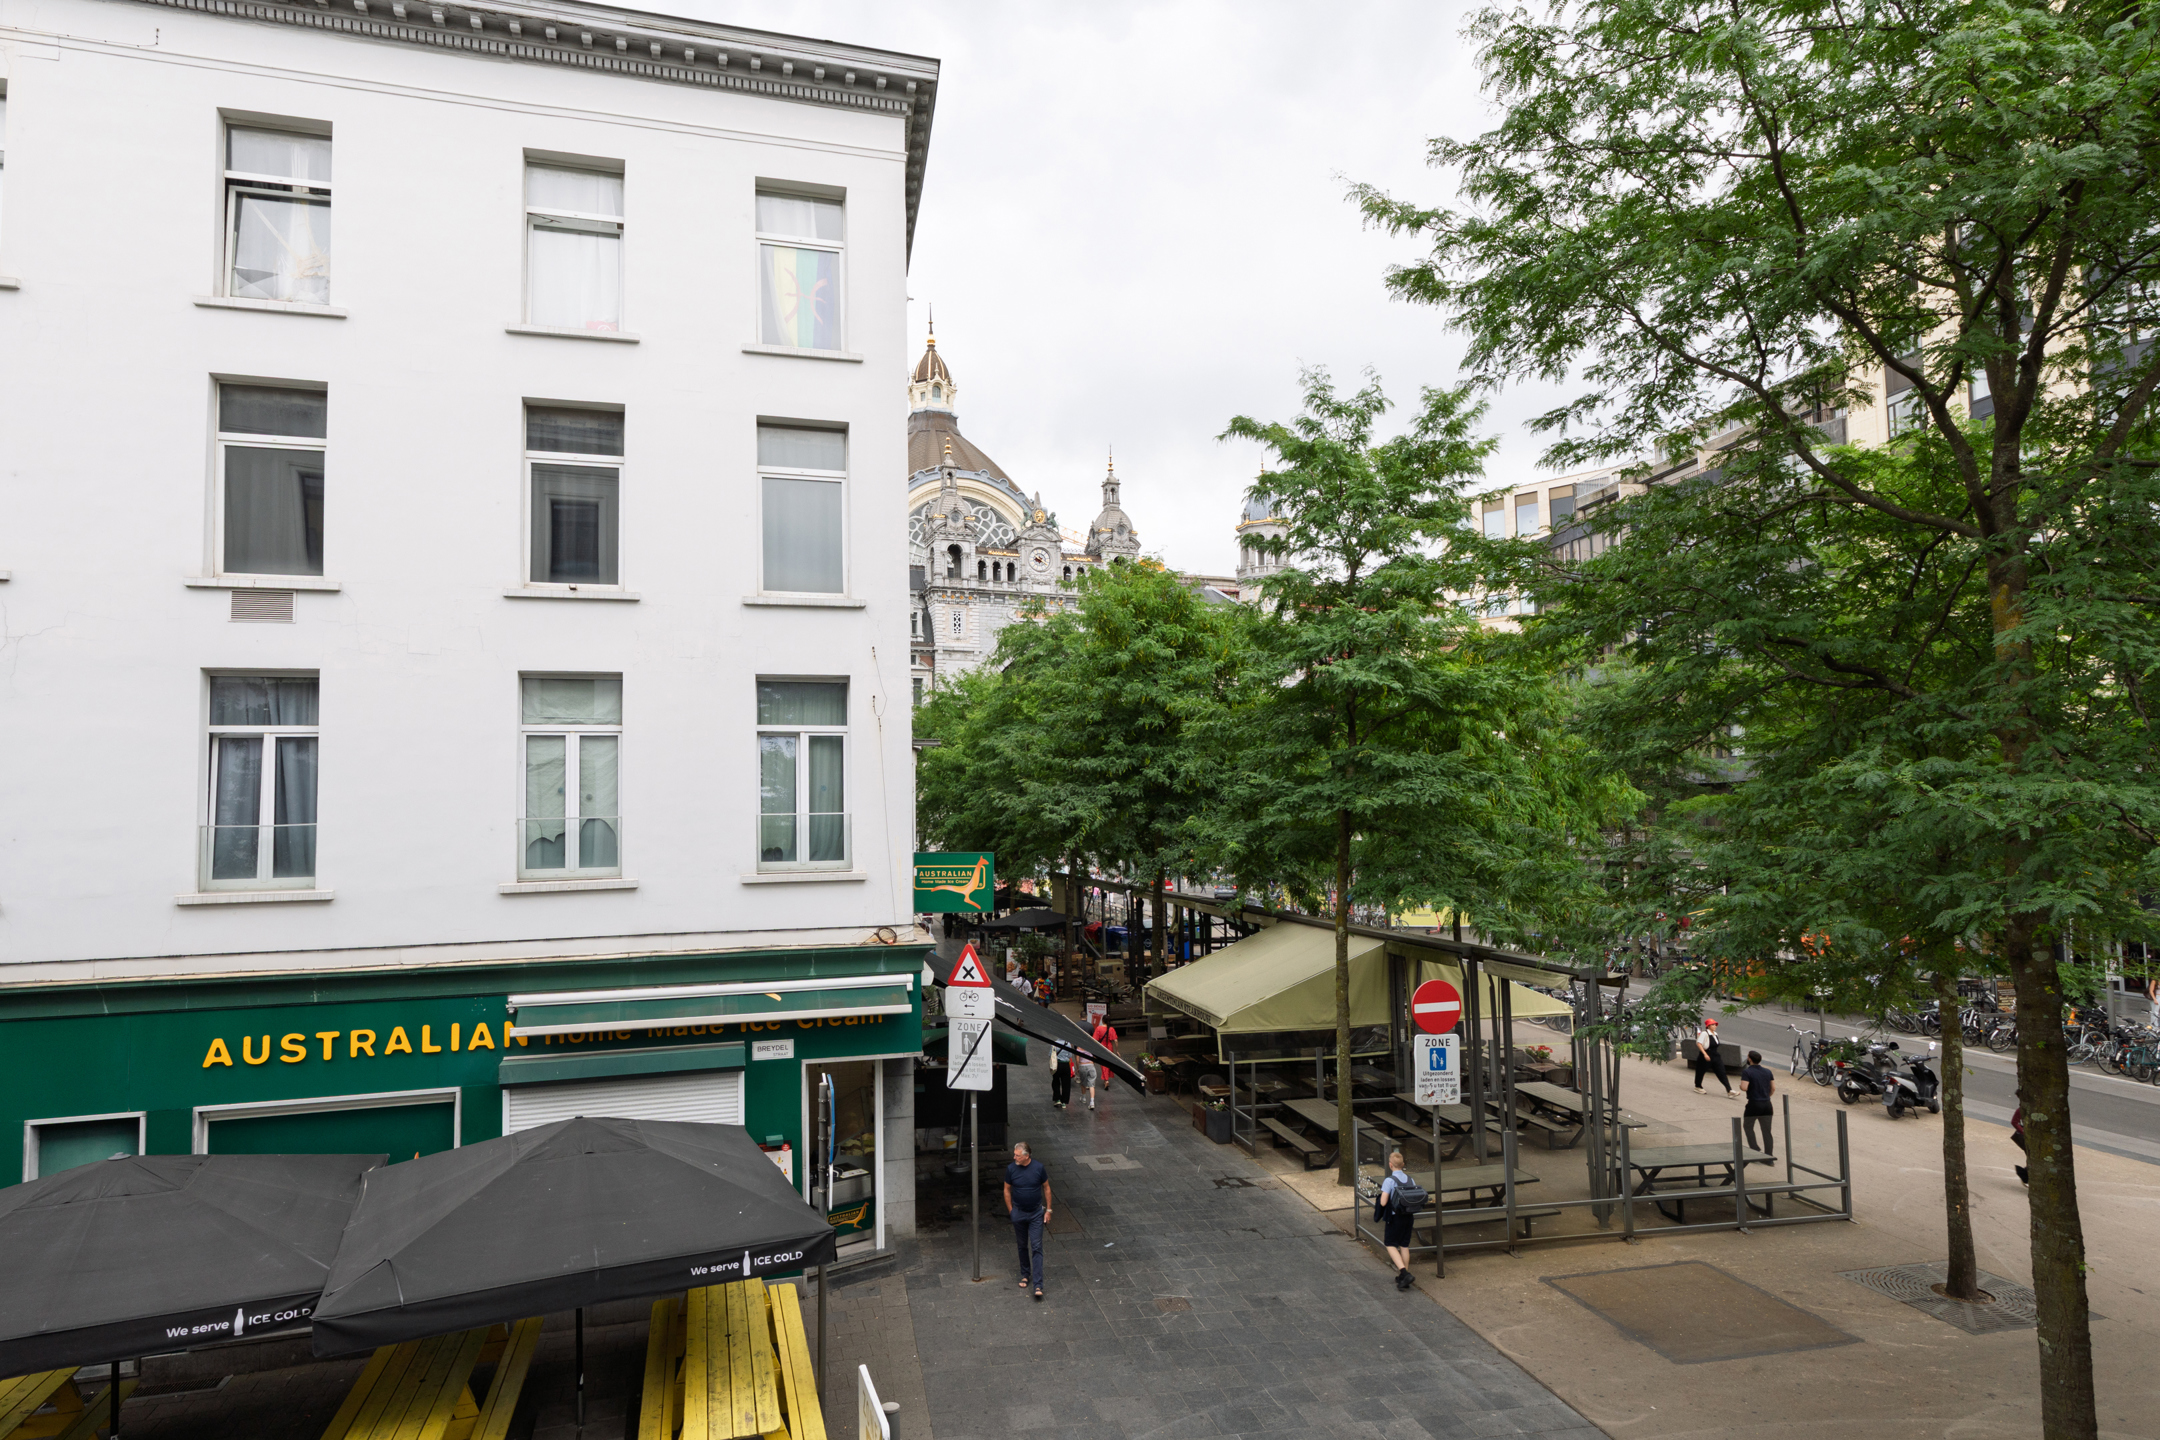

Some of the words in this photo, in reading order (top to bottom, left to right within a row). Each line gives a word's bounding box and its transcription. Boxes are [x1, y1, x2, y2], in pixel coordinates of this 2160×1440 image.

[1156, 990, 1183, 1010] ARGENTINIAN
[1184, 1003, 1211, 1025] STEAKHOUSE
[957, 1022, 982, 1032] ZONE
[202, 1020, 528, 1068] AUSTRALIAN
[757, 1044, 789, 1053] BREYDEL
[1425, 1038, 1451, 1047] ZONE
[690, 1266, 708, 1276] We
[710, 1261, 740, 1273] serve
[754, 1255, 772, 1266] ICE
[773, 1251, 804, 1263] COLD
[166, 1328, 189, 1338] We
[192, 1321, 229, 1335] serve
[248, 1313, 271, 1326] ICE
[274, 1307, 312, 1322] COLD
